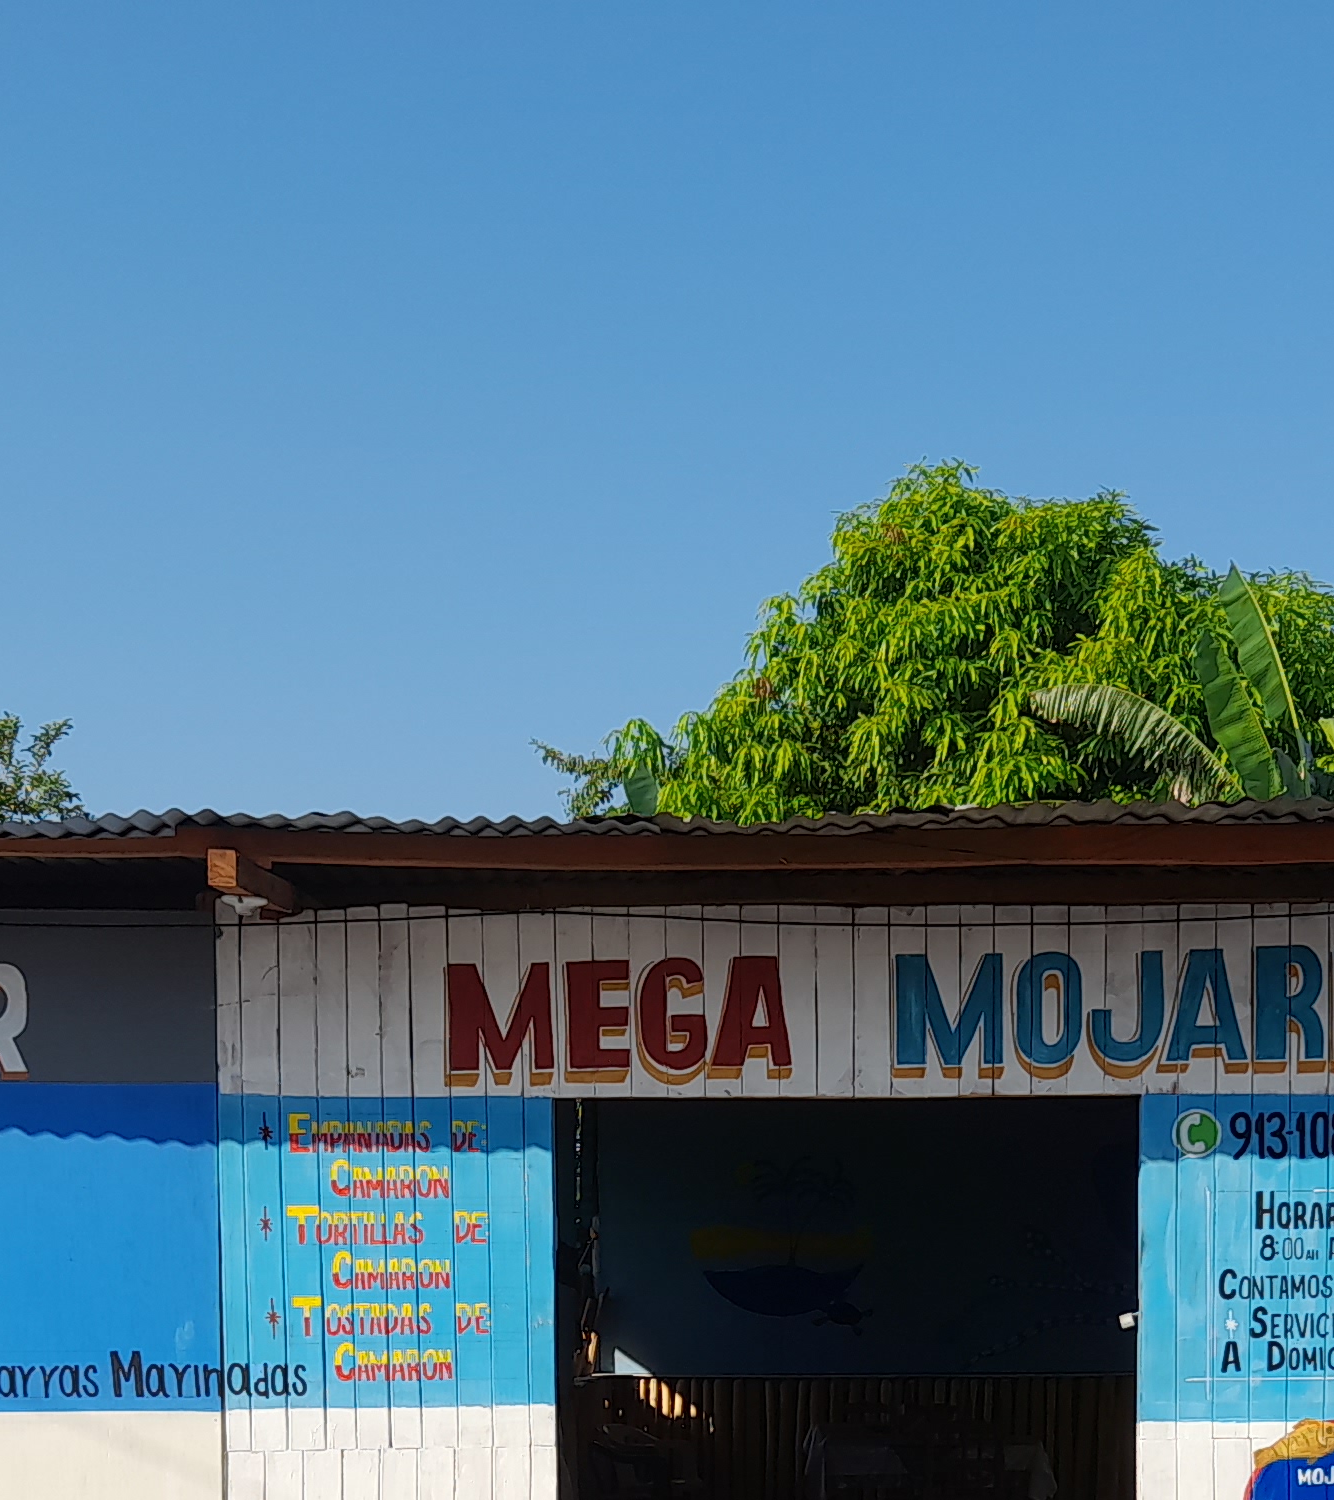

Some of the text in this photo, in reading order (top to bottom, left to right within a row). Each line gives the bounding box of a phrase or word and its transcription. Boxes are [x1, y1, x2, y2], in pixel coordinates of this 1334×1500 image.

[443, 955, 793, 1087] MEGA
[288, 1113, 432, 1153] EMPANADAS
[330, 1159, 450, 1199] CAMARON
[286, 1205, 425, 1245] TORTILLAS
[331, 1251, 451, 1290] CAMARON
[1218, 1268, 1333, 1300] CONTAMOS
[292, 1296, 432, 1337] TOSTADAS
[110, 1350, 308, 1399] Marinadas
[334, 1342, 454, 1382] CAMARON
[1220, 1341, 1241, 1373] A
